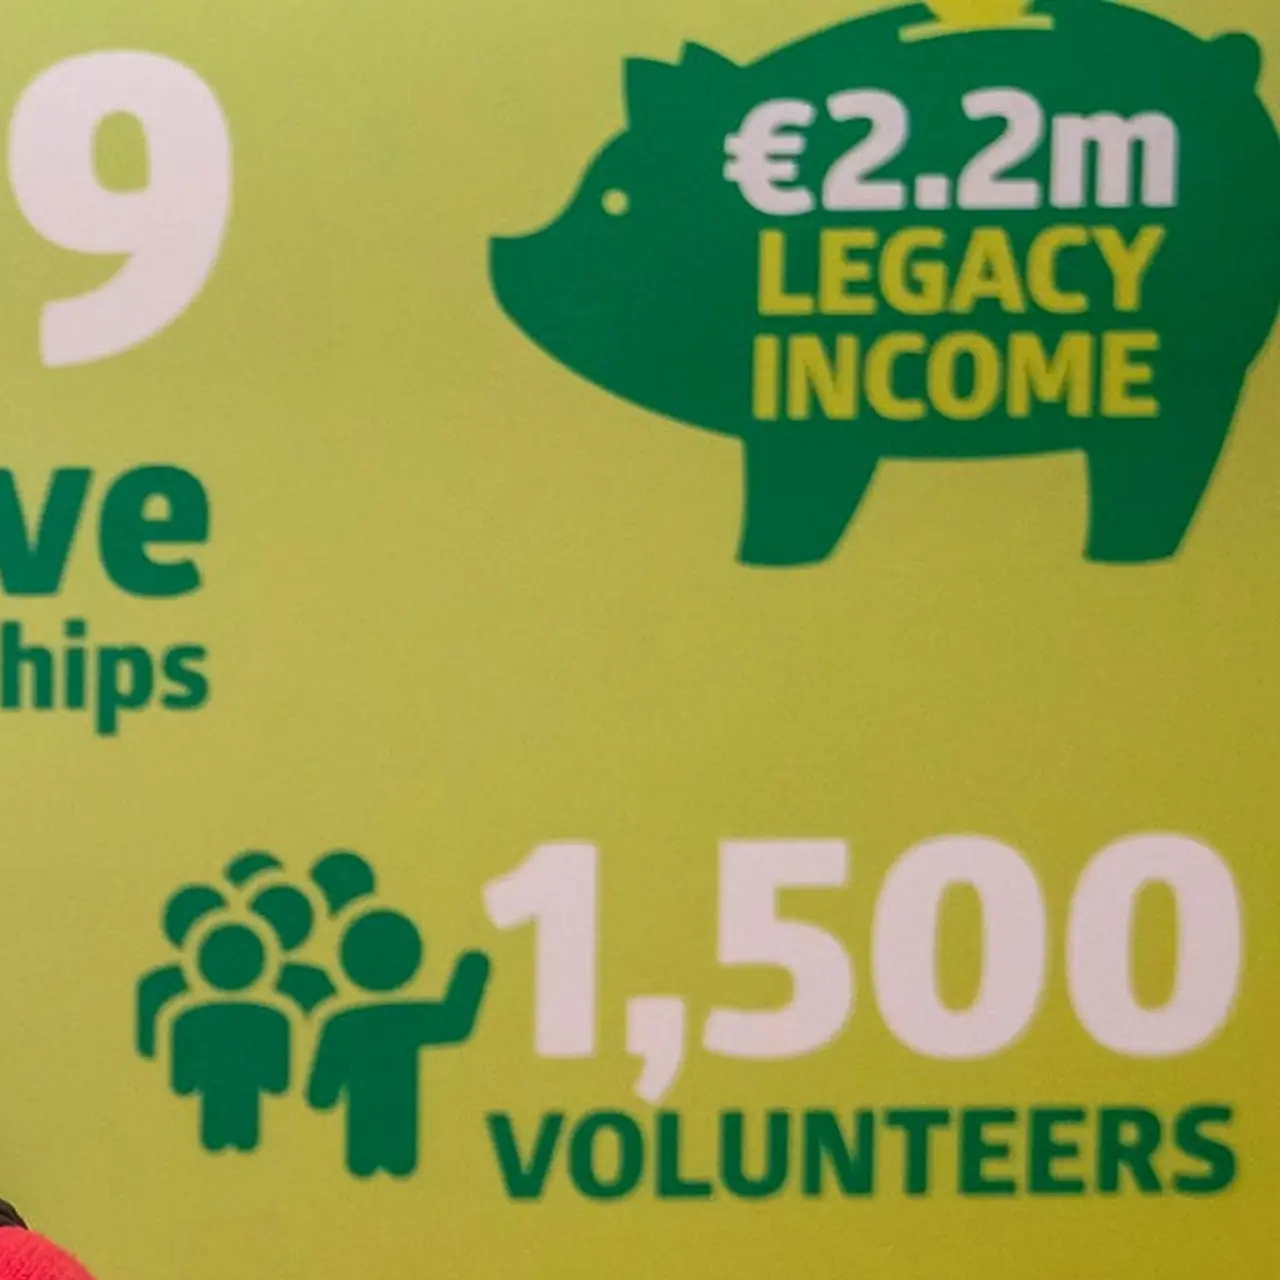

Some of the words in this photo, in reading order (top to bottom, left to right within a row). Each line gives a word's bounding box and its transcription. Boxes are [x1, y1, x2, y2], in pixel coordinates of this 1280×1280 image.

[723, 87, 1178, 216] €2.2m
[757, 225, 1165, 316] LEGACY
[753, 332, 1159, 420] INCOME
[483, 833, 1243, 1104] 1,500
[486, 1103, 1239, 1201] VOLUNTEERS
